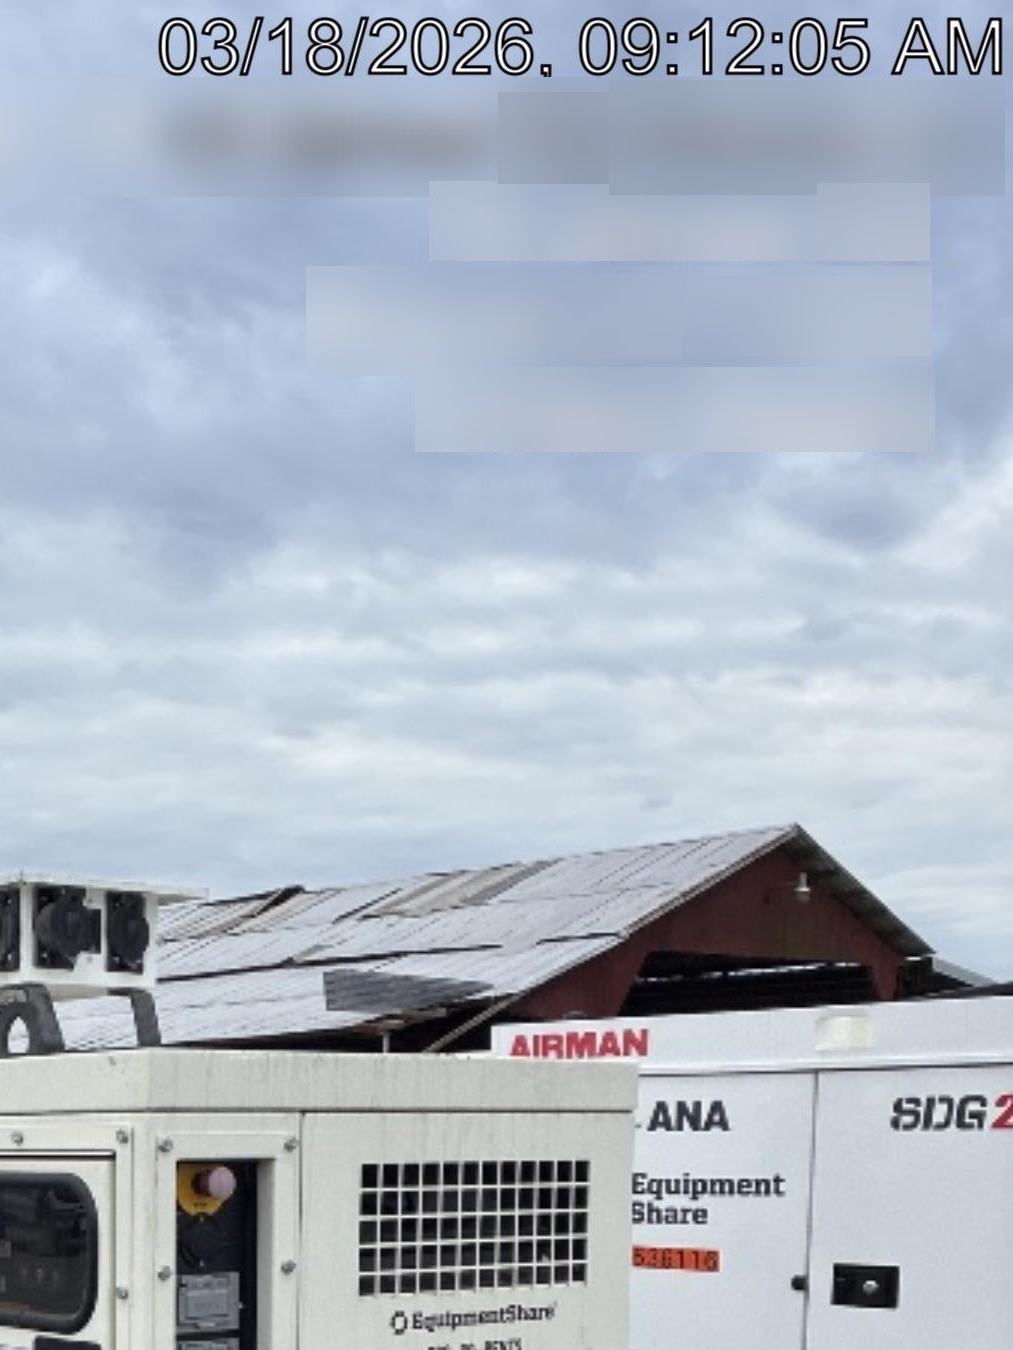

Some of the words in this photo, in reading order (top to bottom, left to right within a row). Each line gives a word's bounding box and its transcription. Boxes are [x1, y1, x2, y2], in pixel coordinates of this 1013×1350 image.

[509, 1028, 649, 1060] AIRMAN
[647, 1099, 731, 1132] ANA
[631, 1172, 787, 1201] Equipment
[631, 1201, 709, 1225] Share
